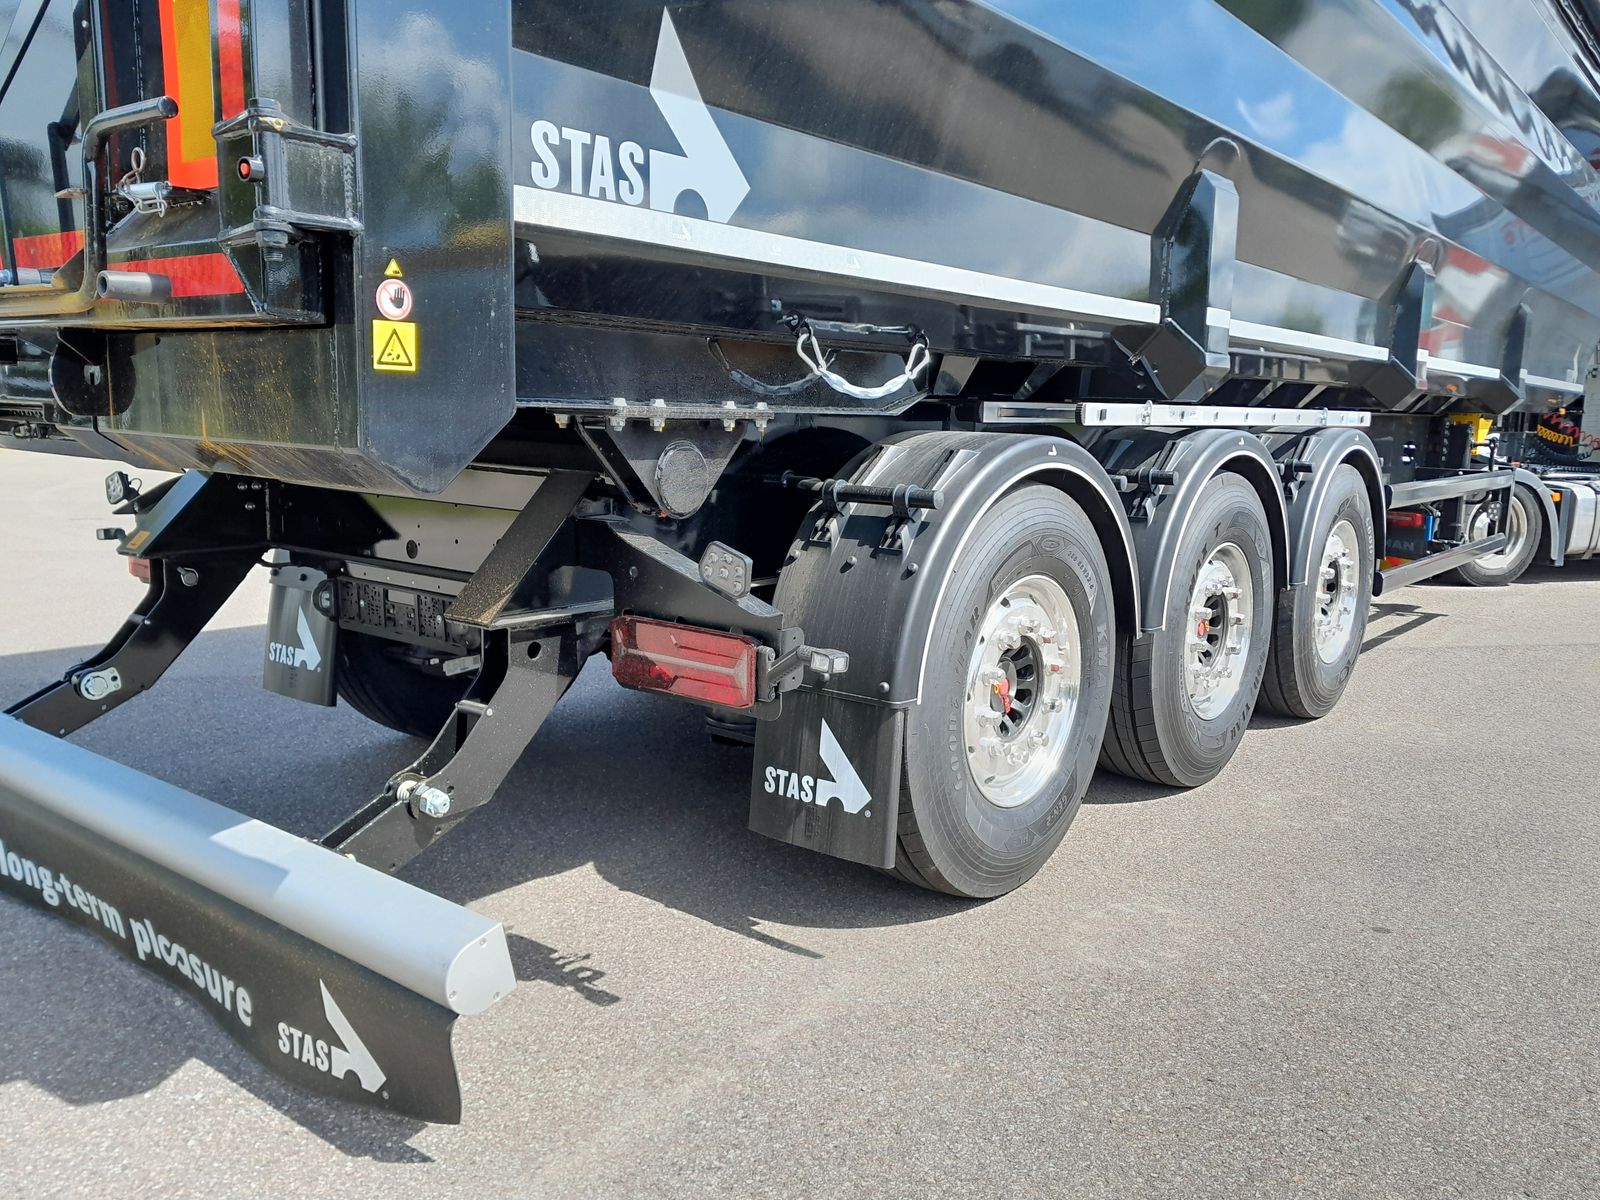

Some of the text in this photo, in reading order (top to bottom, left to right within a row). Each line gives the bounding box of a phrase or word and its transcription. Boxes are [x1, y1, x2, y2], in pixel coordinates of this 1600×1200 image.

[530, 120, 645, 205] STAS
[268, 641, 295, 666] STAS
[764, 766, 814, 803] STAS
[0, 839, 252, 1027] long-term pleasure
[278, 1021, 330, 1072] STAS
